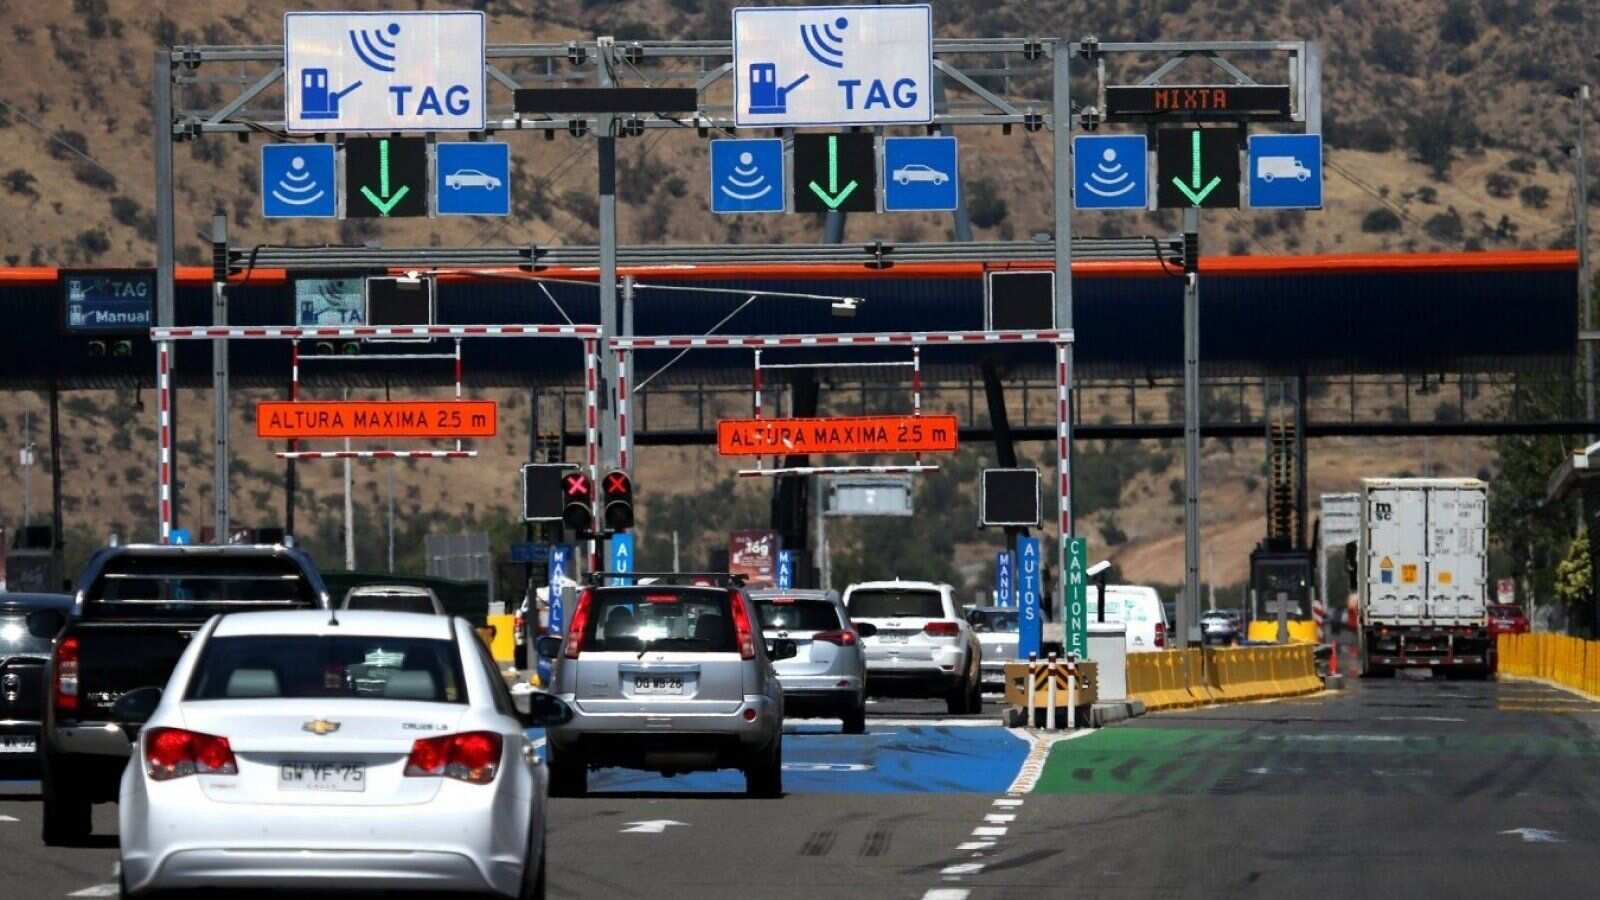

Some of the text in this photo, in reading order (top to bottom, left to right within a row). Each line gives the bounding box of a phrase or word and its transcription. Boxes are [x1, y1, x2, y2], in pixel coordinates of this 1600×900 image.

[388, 84, 471, 116] TAG
[837, 77, 918, 110] TAG
[1154, 88, 1228, 110] MIXTA
[111, 281, 148, 297] TAG
[95, 309, 150, 323] Manual
[269, 410, 345, 429] ALTURA
[353, 410, 429, 429] MAXIMA
[471, 413, 487, 429] m
[730, 427, 806, 447] ALTURA
[814, 425, 889, 445] MAXIMA
[932, 427, 947, 443] m
[551, 551, 564, 622] MANUAL
[1024, 543, 1036, 621] AUTOS
[1070, 540, 1082, 662] CAMIONES
